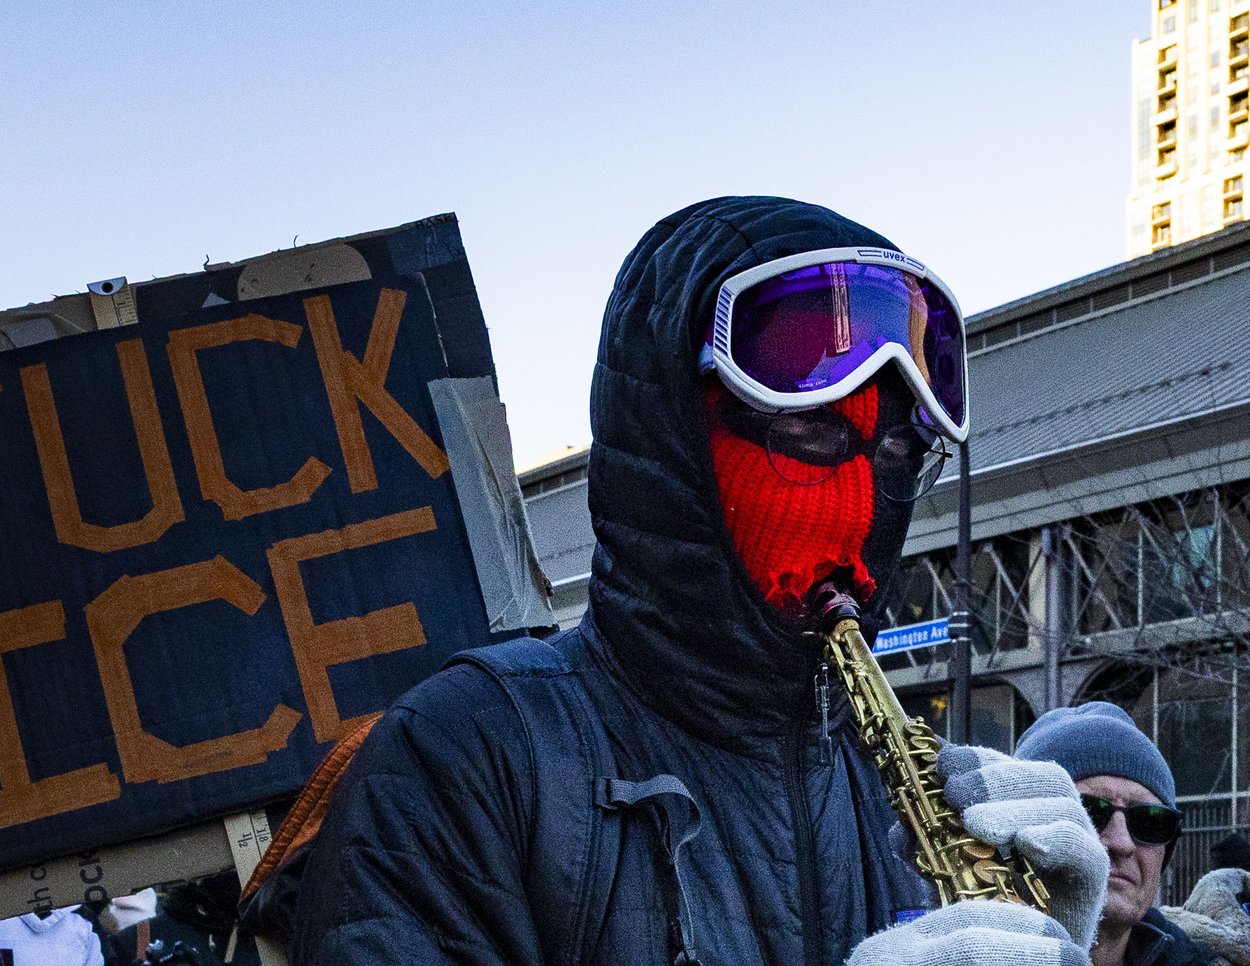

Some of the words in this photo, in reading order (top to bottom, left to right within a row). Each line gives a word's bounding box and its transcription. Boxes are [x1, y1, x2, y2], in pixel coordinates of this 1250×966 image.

[883, 251, 906, 263] uvex
[0, 288, 450, 554] UCK
[876, 630, 929, 651] Washington
